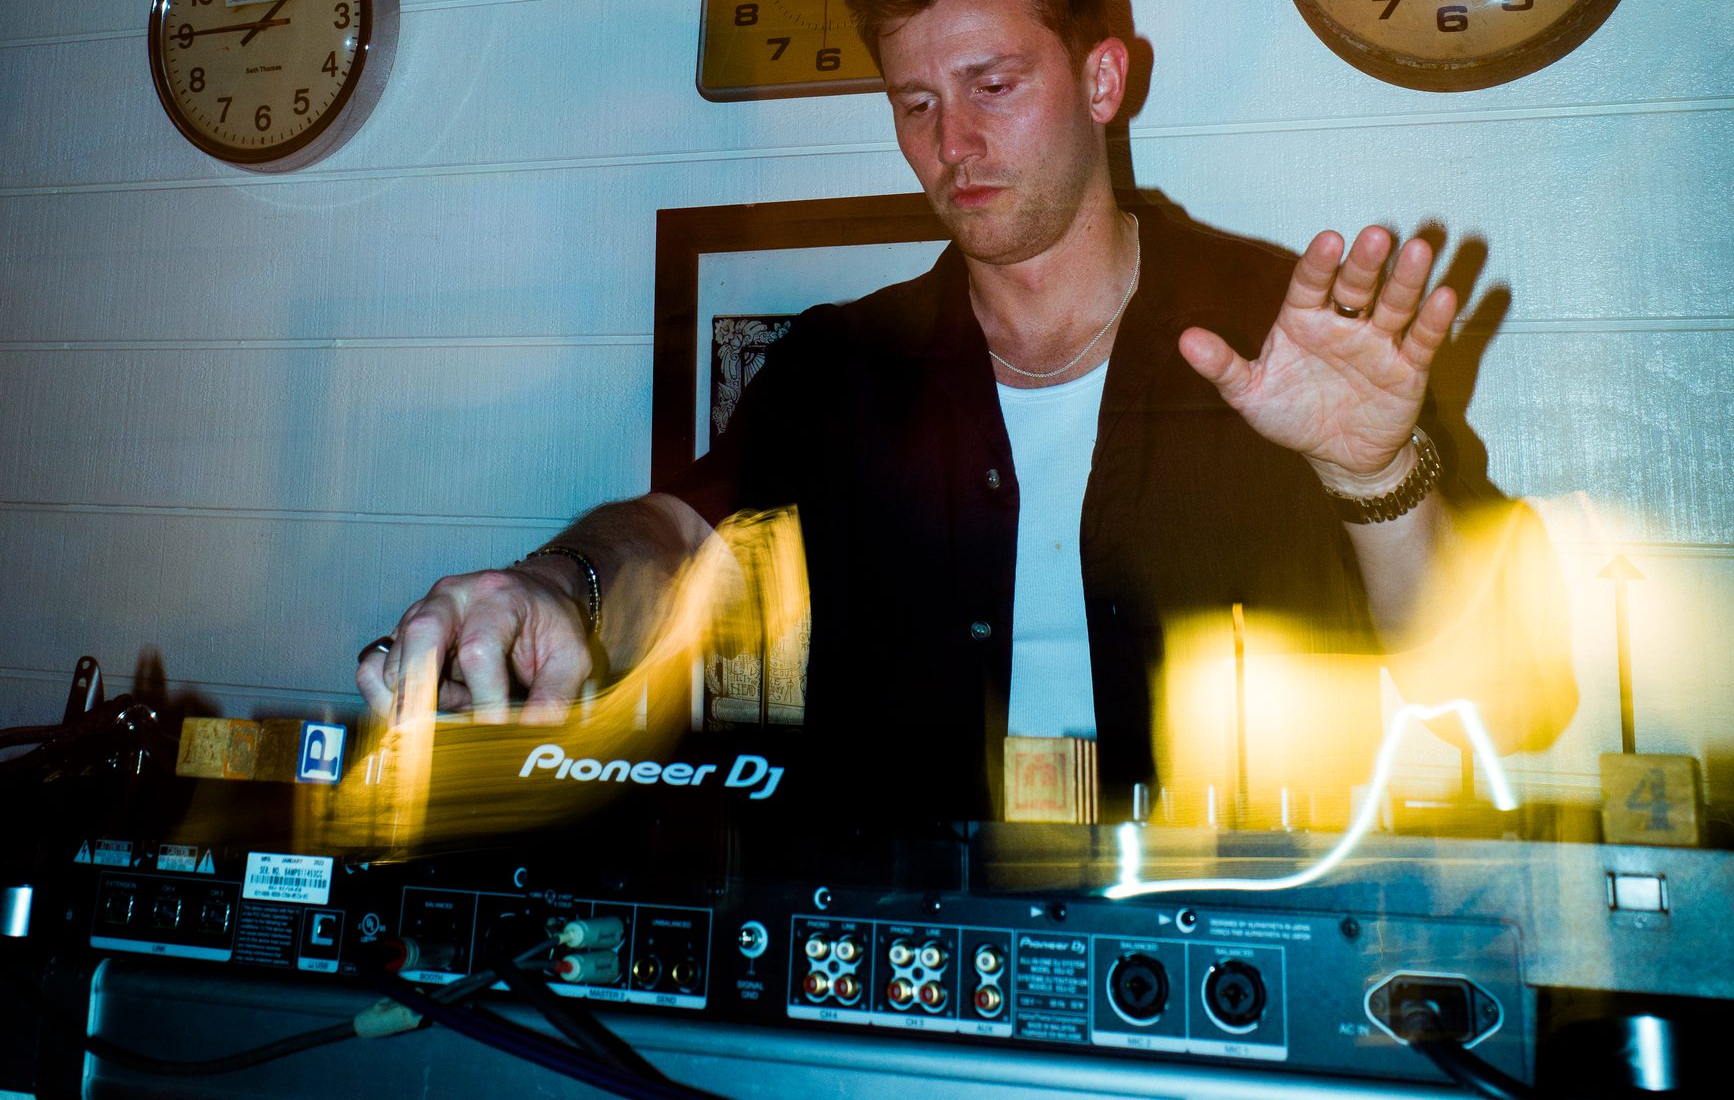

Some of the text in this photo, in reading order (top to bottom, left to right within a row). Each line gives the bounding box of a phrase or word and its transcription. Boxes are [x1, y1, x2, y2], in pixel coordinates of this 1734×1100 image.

[334, 2, 350, 29] 3
[734, 3, 758, 26] 8
[1436, 5, 1468, 32] 6
[178, 23, 194, 50] 9
[766, 37, 790, 61] 7
[321, 51, 338, 77] 4
[816, 48, 841, 71] 6
[189, 67, 205, 93] 8
[217, 97, 233, 123] 7
[293, 88, 310, 115] 5
[255, 105, 272, 131] 6
[304, 729, 339, 777] P
[518, 743, 718, 787] Pioneer
[1625, 767, 1675, 832] 4
[1020, 936, 1069, 951] Pioneer
[589, 989, 619, 999] MASTER
[656, 996, 677, 1005] SEND
[1339, 1023, 1369, 1036] AC IN
